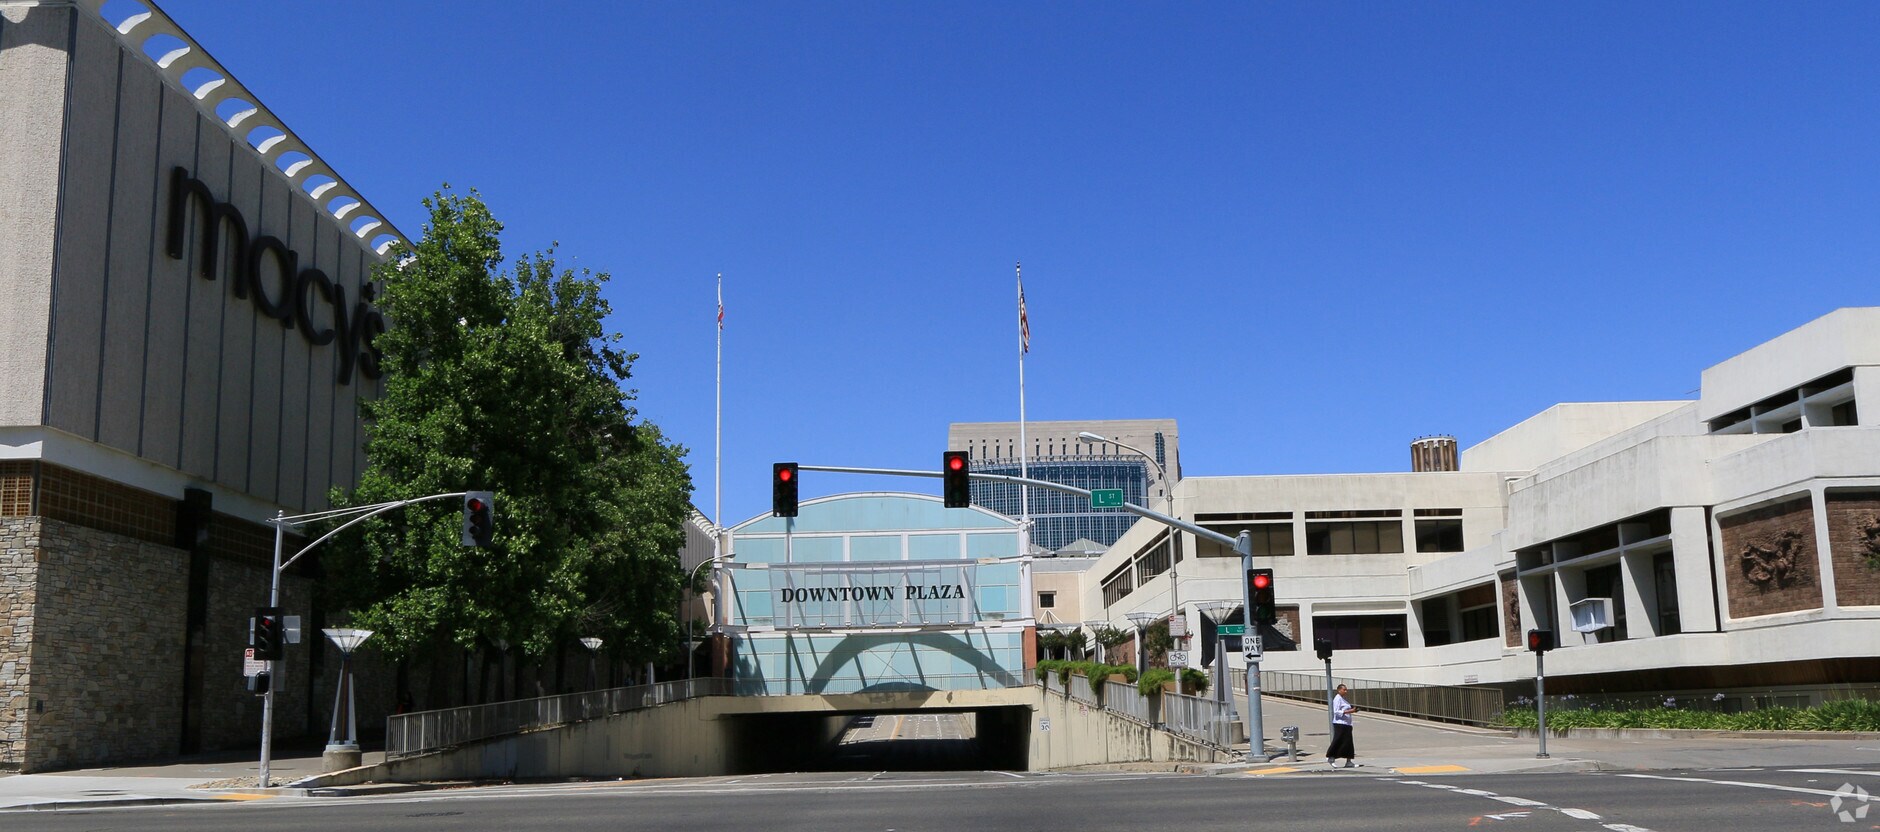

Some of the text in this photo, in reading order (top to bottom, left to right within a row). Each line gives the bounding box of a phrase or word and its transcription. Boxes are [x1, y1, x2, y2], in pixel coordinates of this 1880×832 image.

[1099, 494, 1104, 504] L
[781, 584, 966, 603] DOWNTOWN PLAZA
